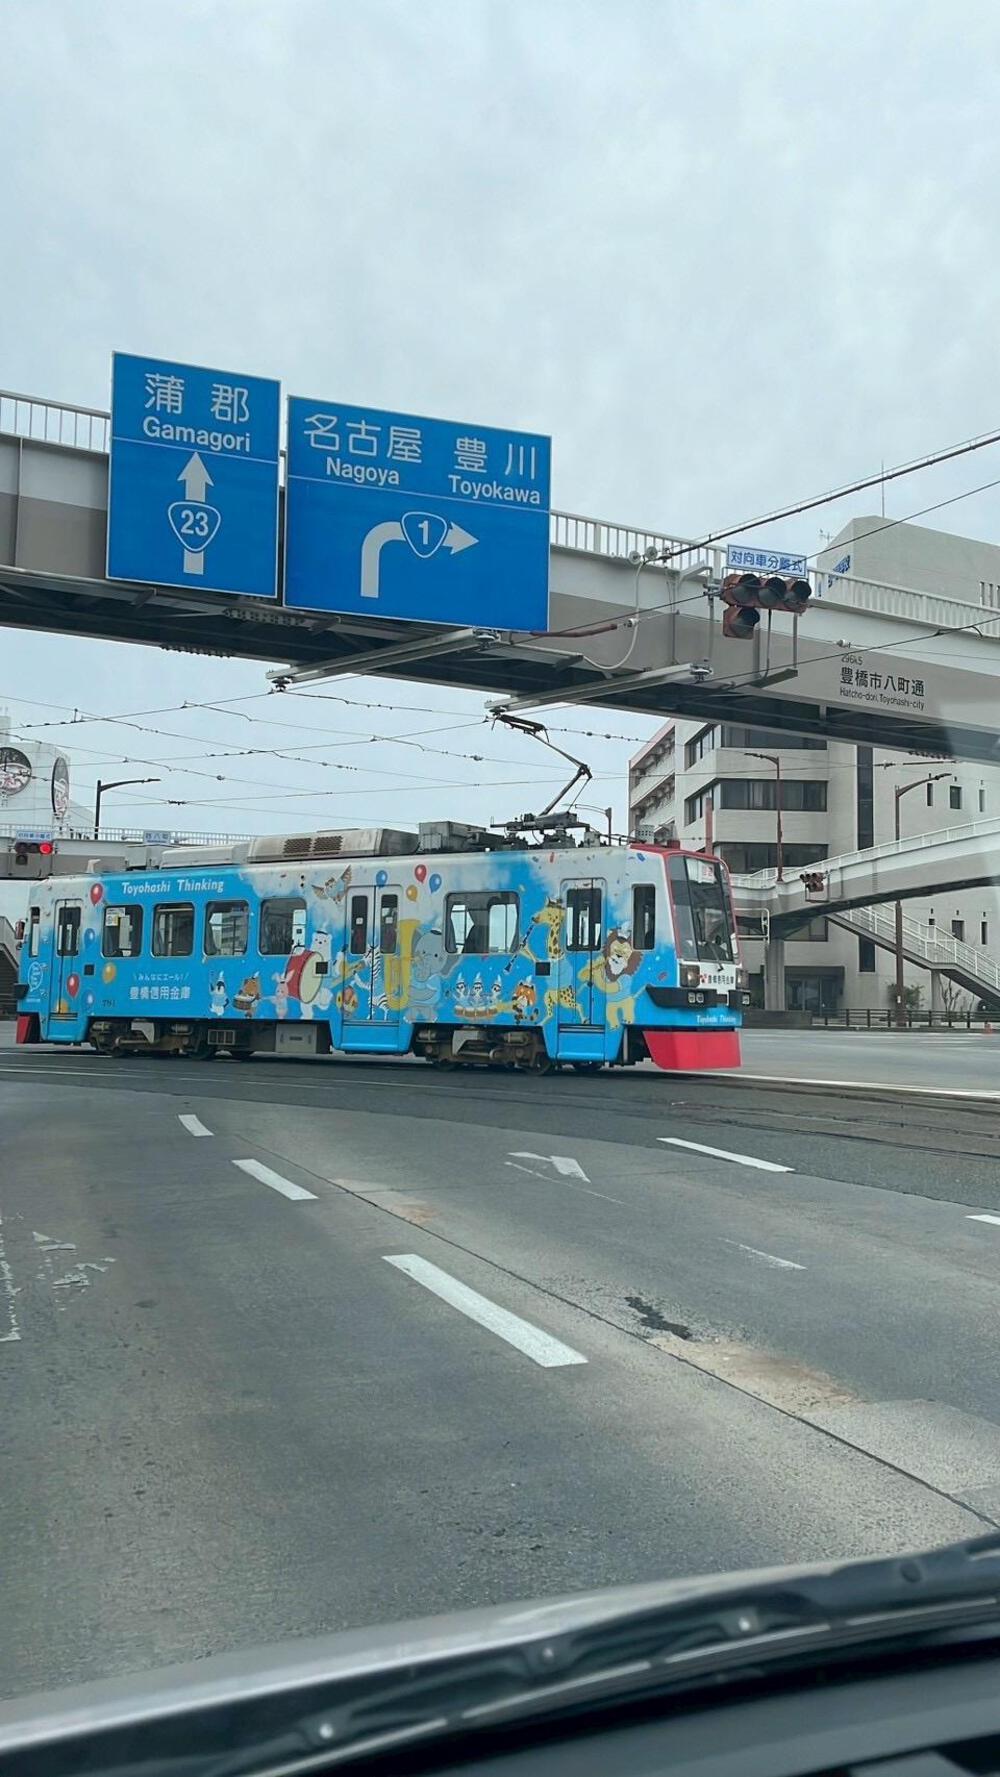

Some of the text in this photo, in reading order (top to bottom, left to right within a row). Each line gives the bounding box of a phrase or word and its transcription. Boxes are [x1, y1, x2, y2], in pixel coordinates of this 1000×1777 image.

[144, 372, 250, 424] 蒲郡
[143, 415, 251, 453] Gamagori
[304, 413, 537, 480] 名古屋 豊川
[326, 456, 540, 505] Nagoya Toyokawa
[180, 509, 210, 537] 23
[418, 520, 431, 545] 1
[840, 666, 925, 697] 豊橋市八町通
[121, 878, 224, 896] Toyohashi Thinking
